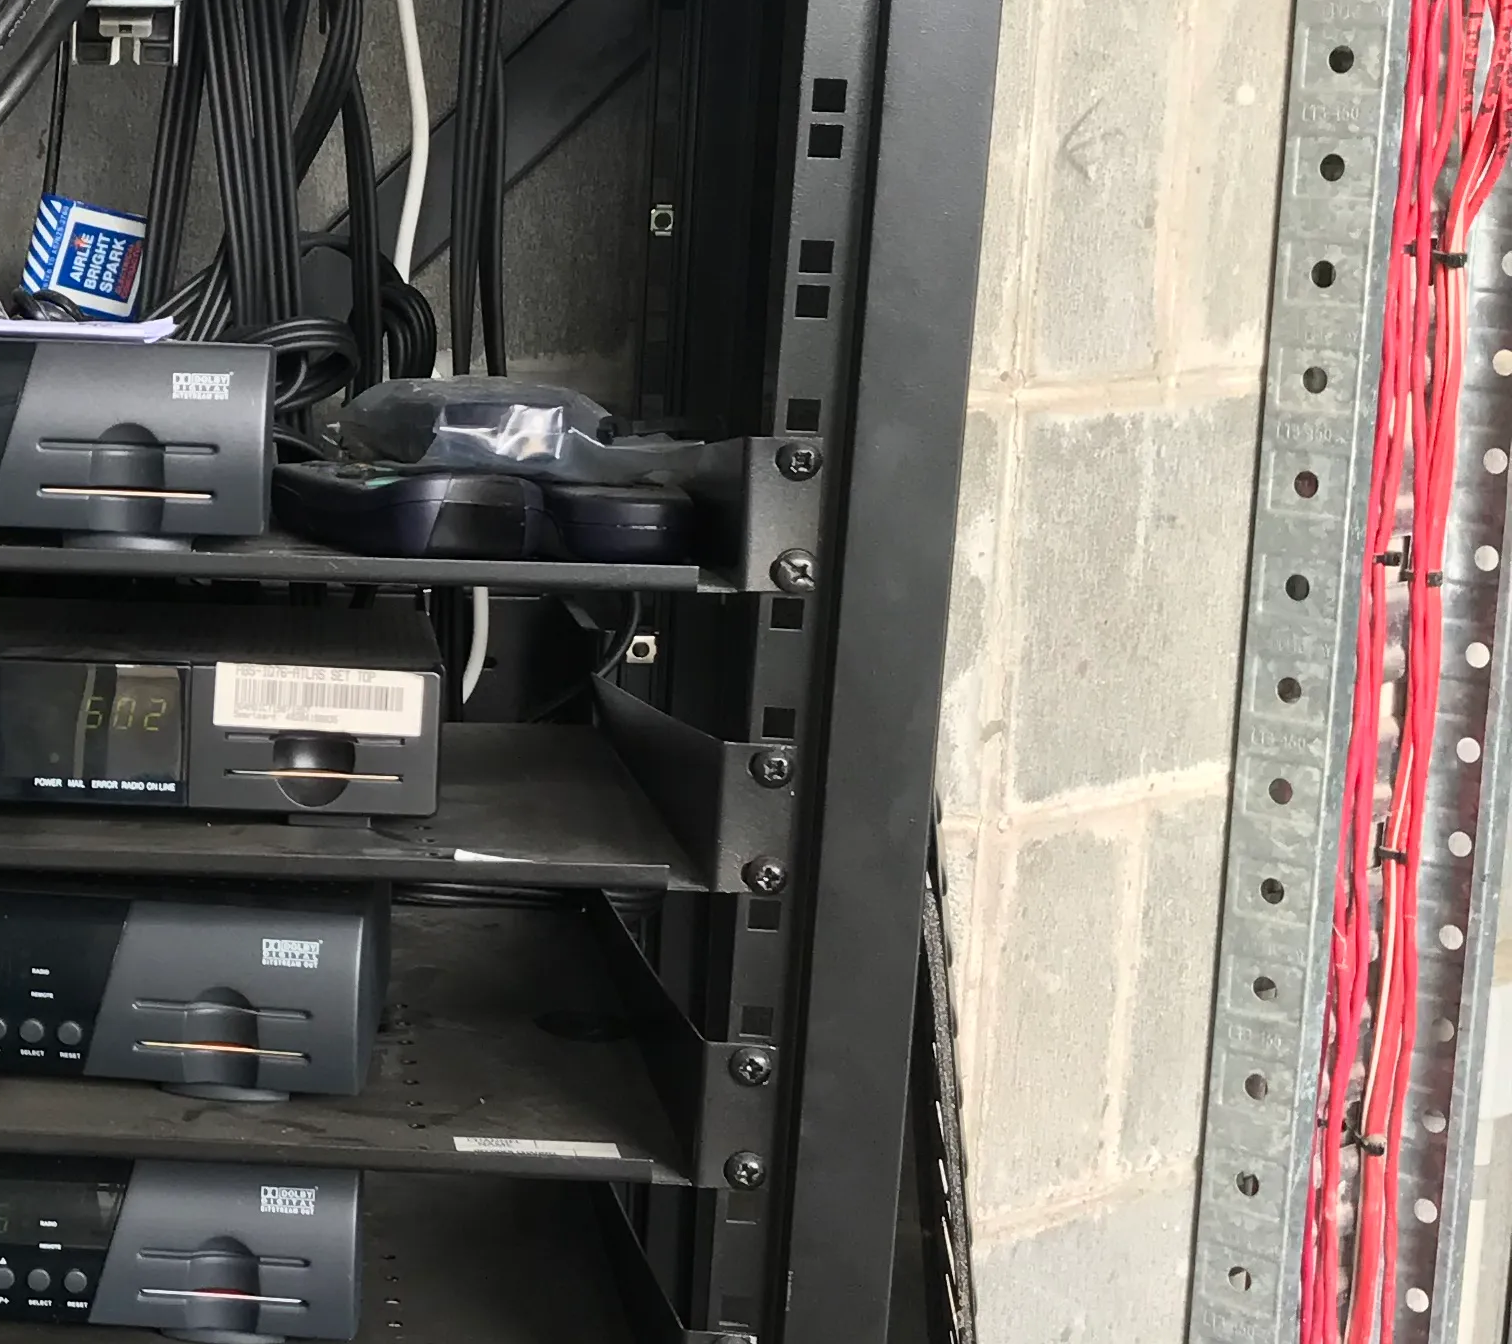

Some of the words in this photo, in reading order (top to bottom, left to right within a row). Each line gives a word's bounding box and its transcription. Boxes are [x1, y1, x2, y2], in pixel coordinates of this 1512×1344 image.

[69, 232, 95, 283] AIRLIE
[84, 232, 111, 290] BRIGHT
[99, 238, 127, 294] SPARK
[331, 669, 350, 682] SET
[34, 778, 62, 788] POWER
[91, 780, 118, 790] ERROR
[121, 781, 144, 791] RADIO
